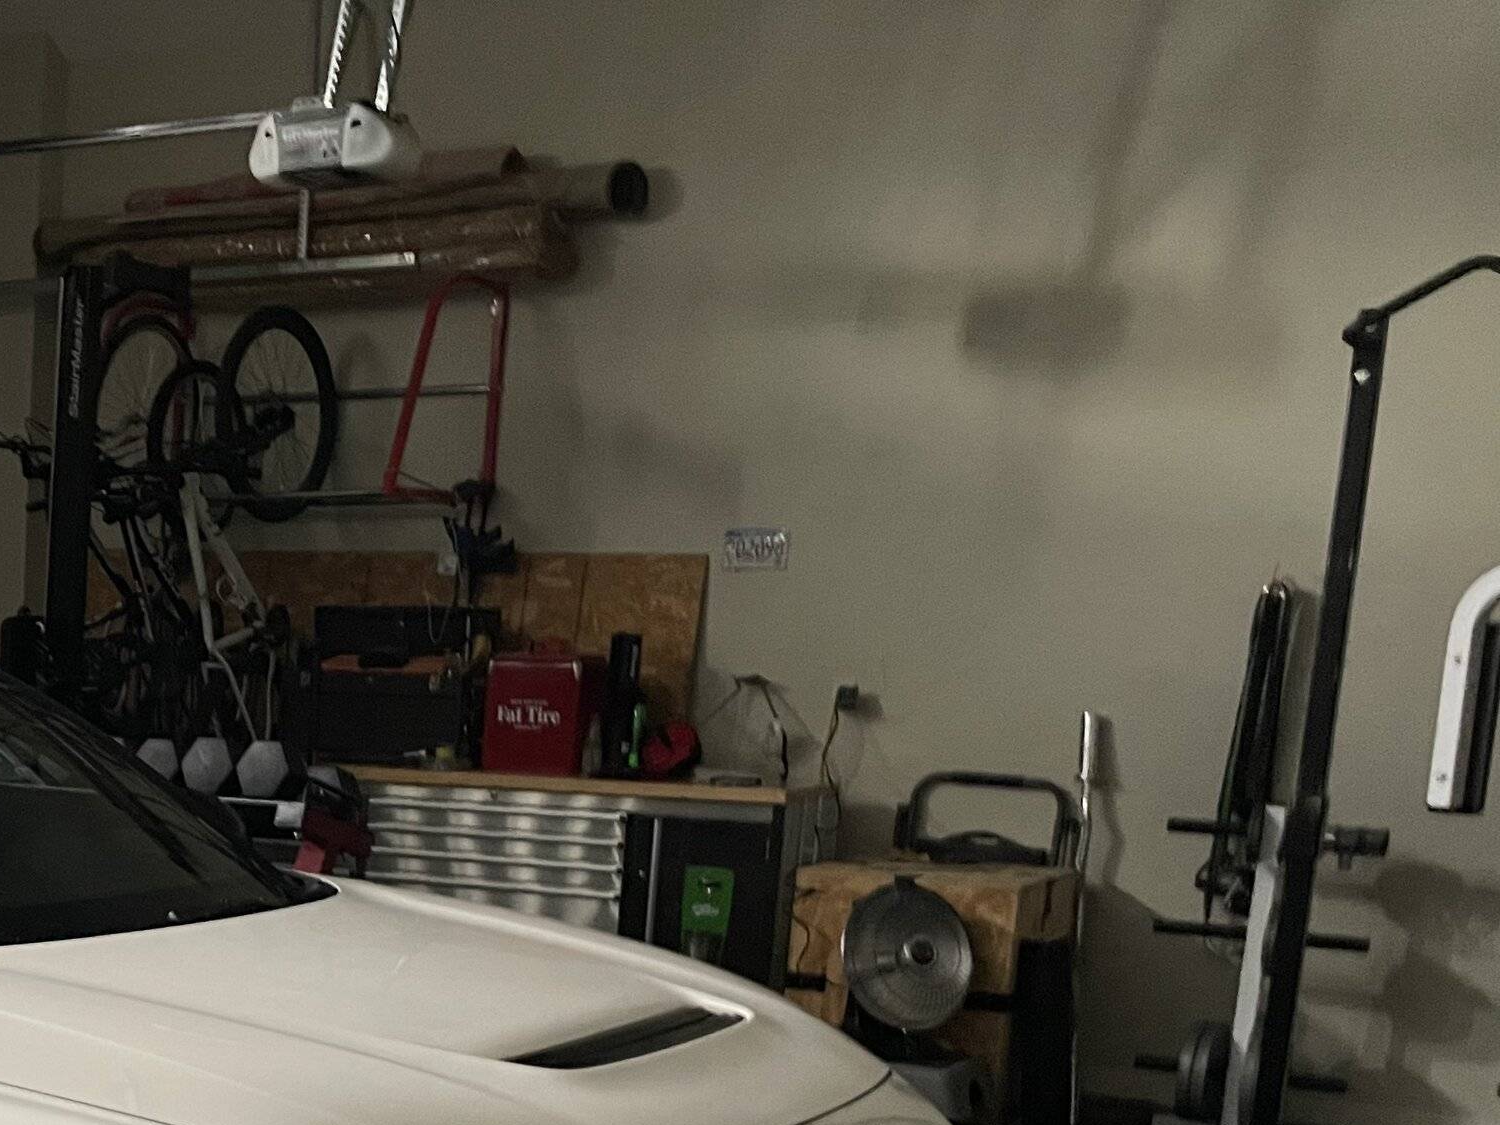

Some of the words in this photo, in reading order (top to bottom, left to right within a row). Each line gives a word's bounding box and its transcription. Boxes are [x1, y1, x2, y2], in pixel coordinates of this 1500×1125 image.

[68, 295, 84, 418] StairMaster
[496, 705, 522, 724] Fat
[526, 705, 561, 726] Tire
